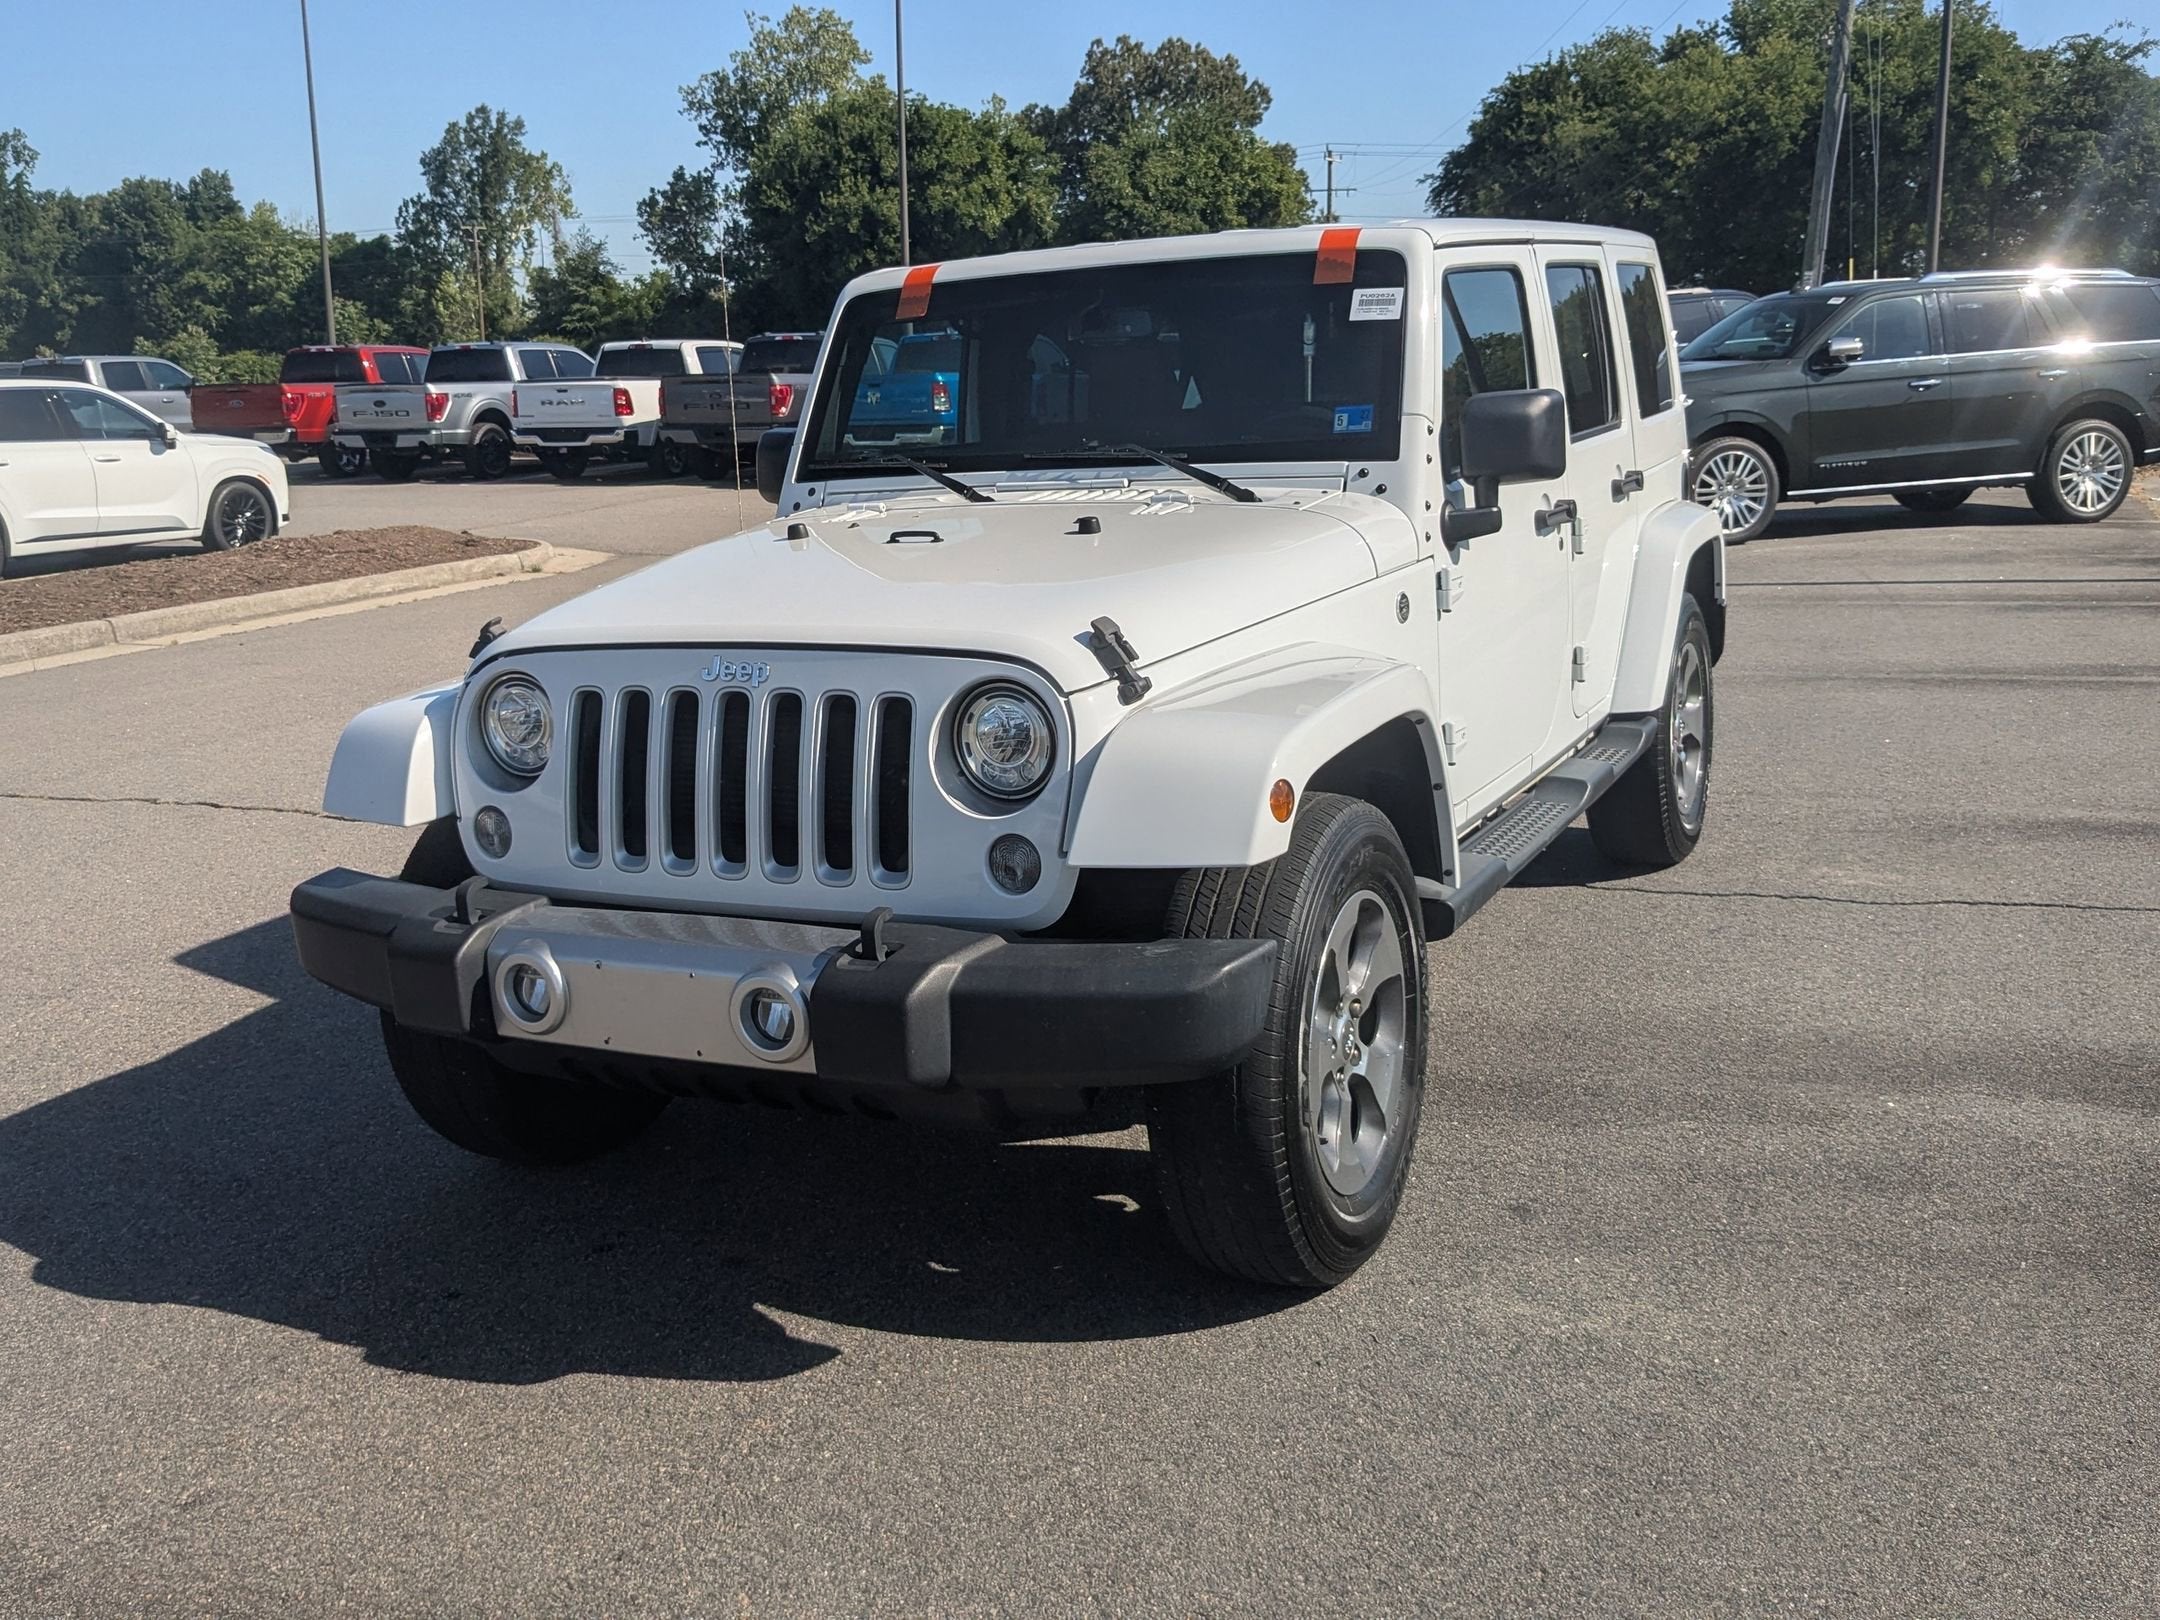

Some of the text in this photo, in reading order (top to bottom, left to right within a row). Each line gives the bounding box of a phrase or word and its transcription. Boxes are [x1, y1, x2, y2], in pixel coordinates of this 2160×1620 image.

[353, 410, 410, 418] F-150
[1337, 415, 1344, 427] 5
[701, 655, 771, 688] Jeep
